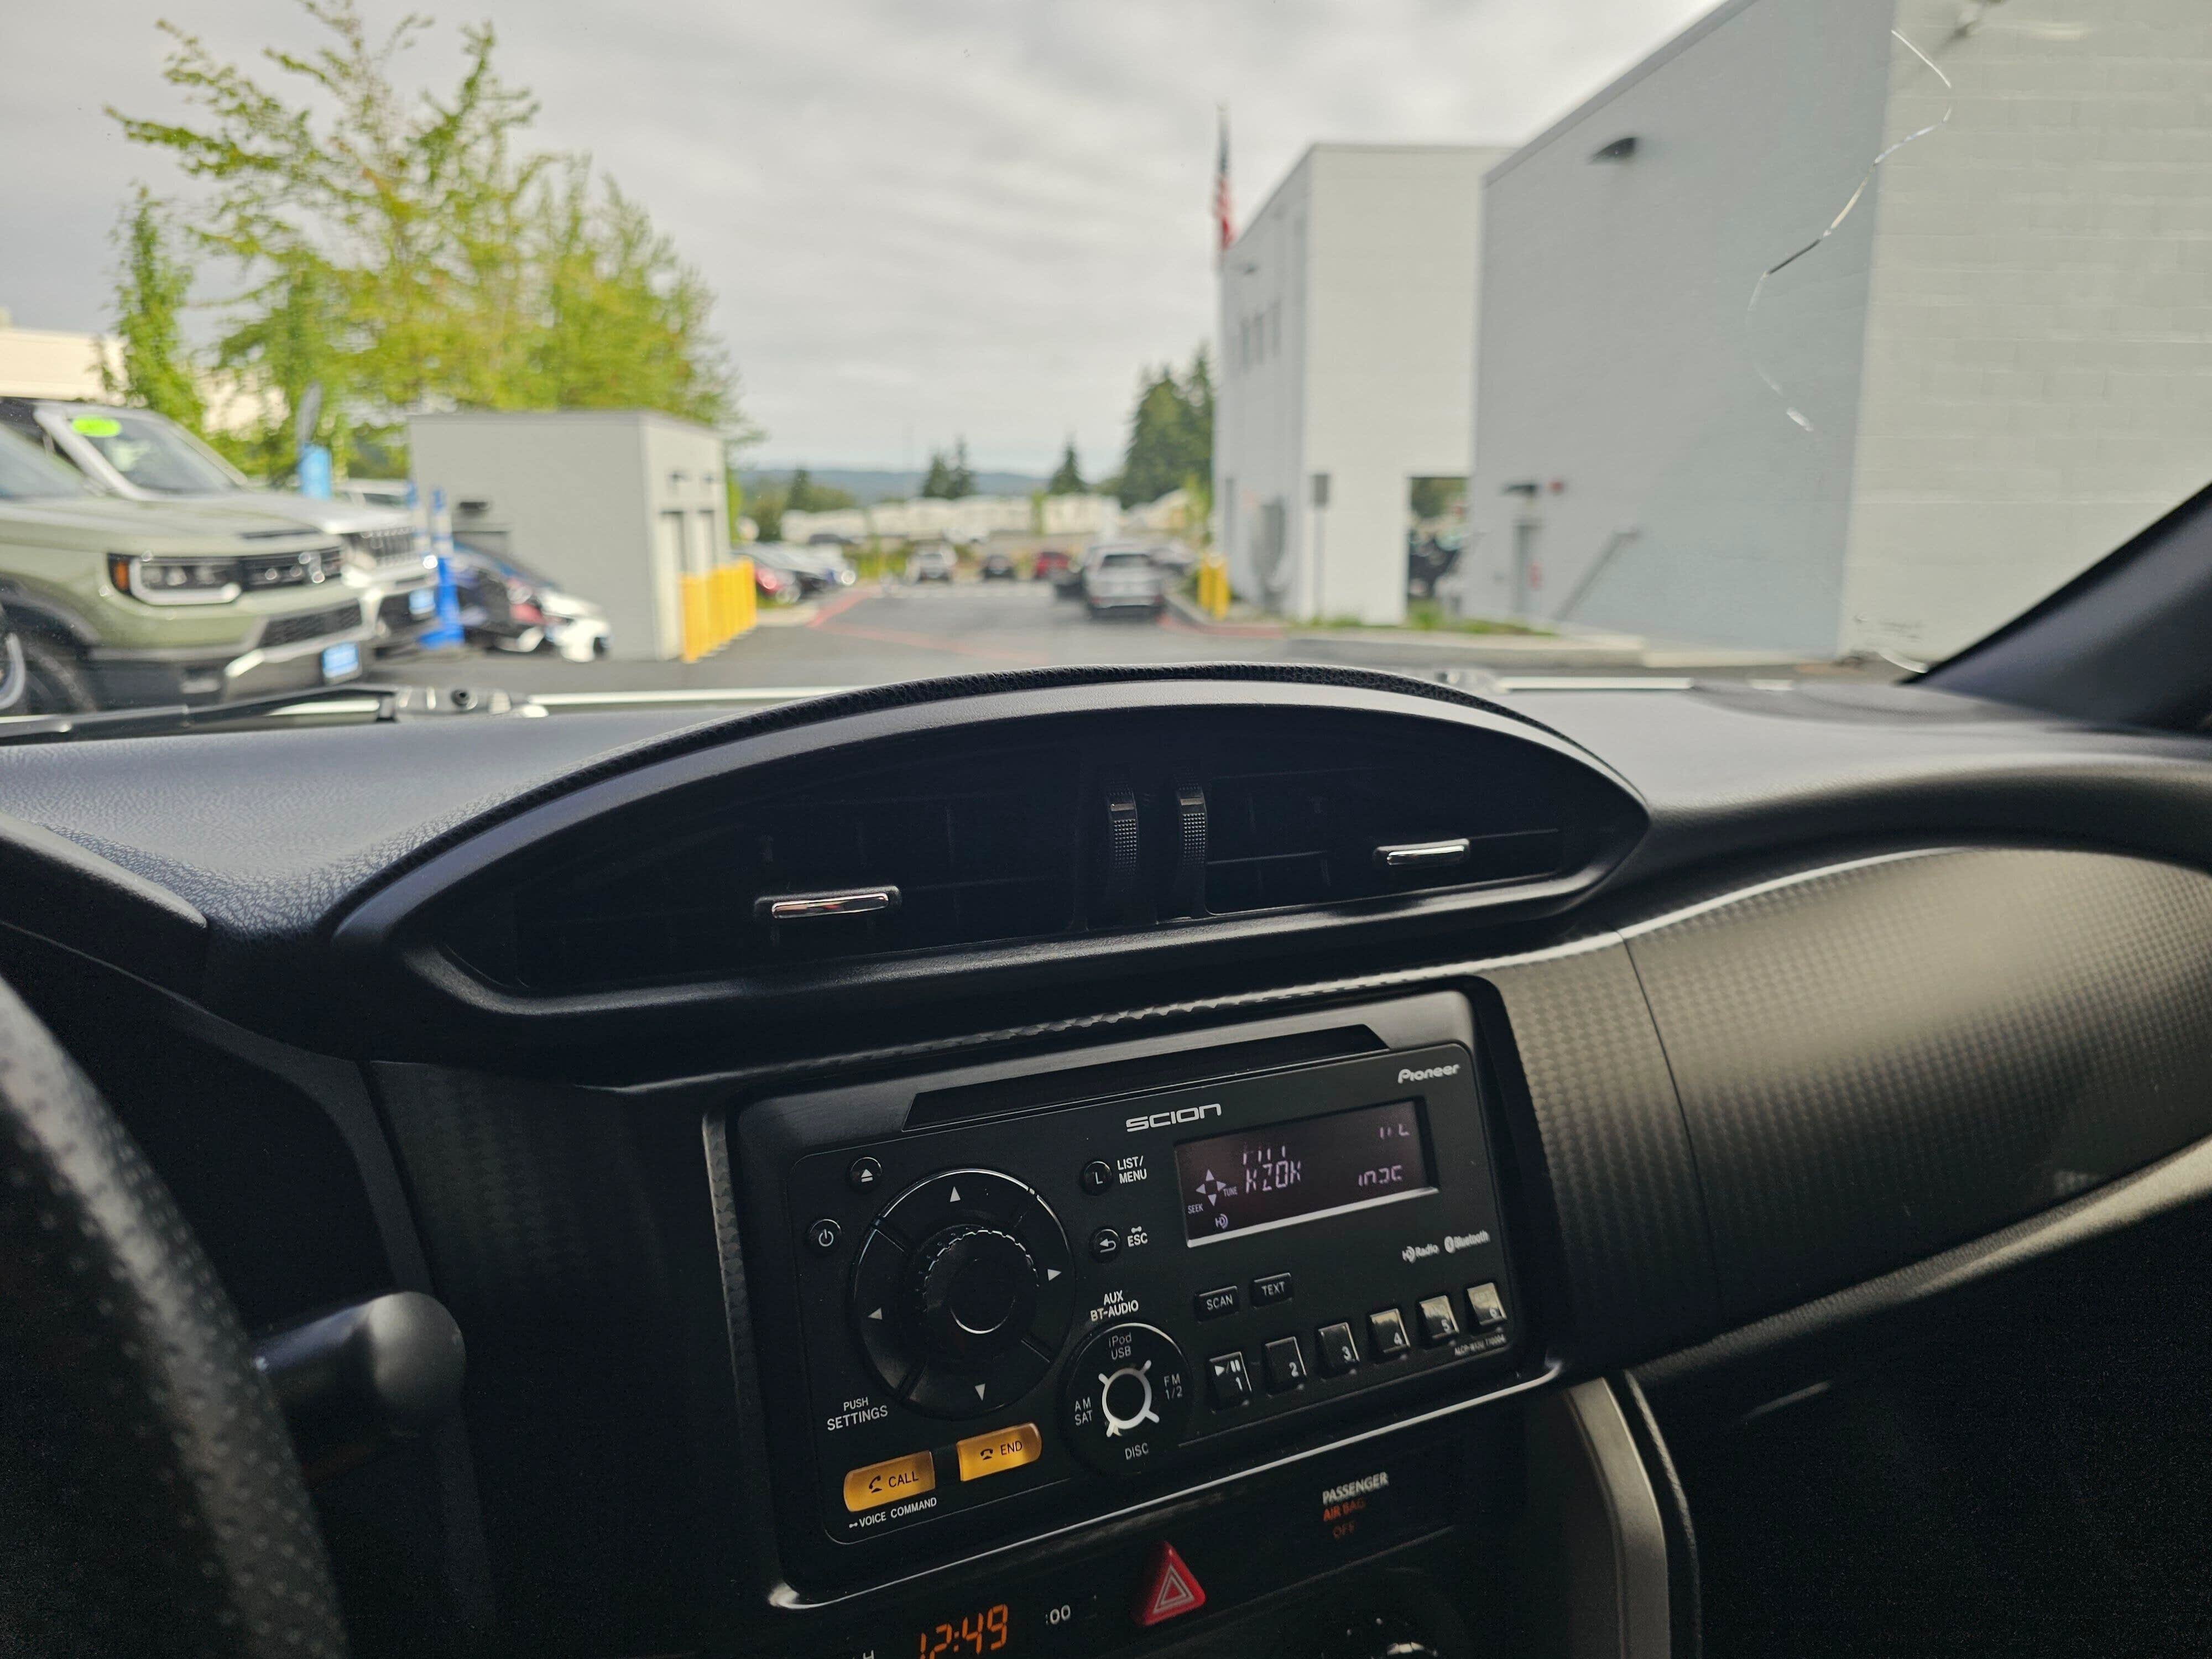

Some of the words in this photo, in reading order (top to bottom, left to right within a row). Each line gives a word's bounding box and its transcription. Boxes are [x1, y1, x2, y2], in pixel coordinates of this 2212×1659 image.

[1397, 1063, 1460, 1084] Pioneer
[1126, 1103, 1221, 1133] SCION
[1117, 1155, 1143, 1170] LIST/
[1119, 1168, 1147, 1184] MENU
[1223, 1187, 1238, 1197] TUNE
[1188, 1203, 1204, 1214] SEEK
[1128, 1233, 1148, 1247] ESC
[1454, 1229, 1490, 1250] Bluetooth
[1261, 1281, 1285, 1296] TEXT
[1103, 1290, 1123, 1306] AUX
[1206, 1294, 1233, 1311] SCAN
[1090, 1300, 1139, 1322] BT-AUDIO
[1441, 1319, 1452, 1334] 5
[1109, 1332, 1131, 1348] iPod
[1394, 1332, 1402, 1345] 4
[1111, 1345, 1131, 1360] USB
[1343, 1345, 1353, 1362] 3
[1289, 1362, 1299, 1377] 2
[1235, 1376, 1243, 1391] 1
[1166, 1386, 1182, 1400] 1/2
[843, 1396, 869, 1411] PUSH
[827, 1405, 888, 1431] SETTINGS
[1074, 1410, 1093, 1426] SAT
[1000, 1441, 1022, 1455] END
[1125, 1443, 1149, 1460] DISC
[888, 1471, 919, 1488] CALL
[1323, 1472, 1389, 1505] PASSENGER
[859, 1511, 886, 1527] VOICE
[890, 1496, 937, 1517] COMMAND
[1323, 1505, 1341, 1522] AIR
[1342, 1498, 1365, 1515] BAG
[1333, 1521, 1355, 1539] OFF
[920, 1604, 1009, 1659] 12:49
